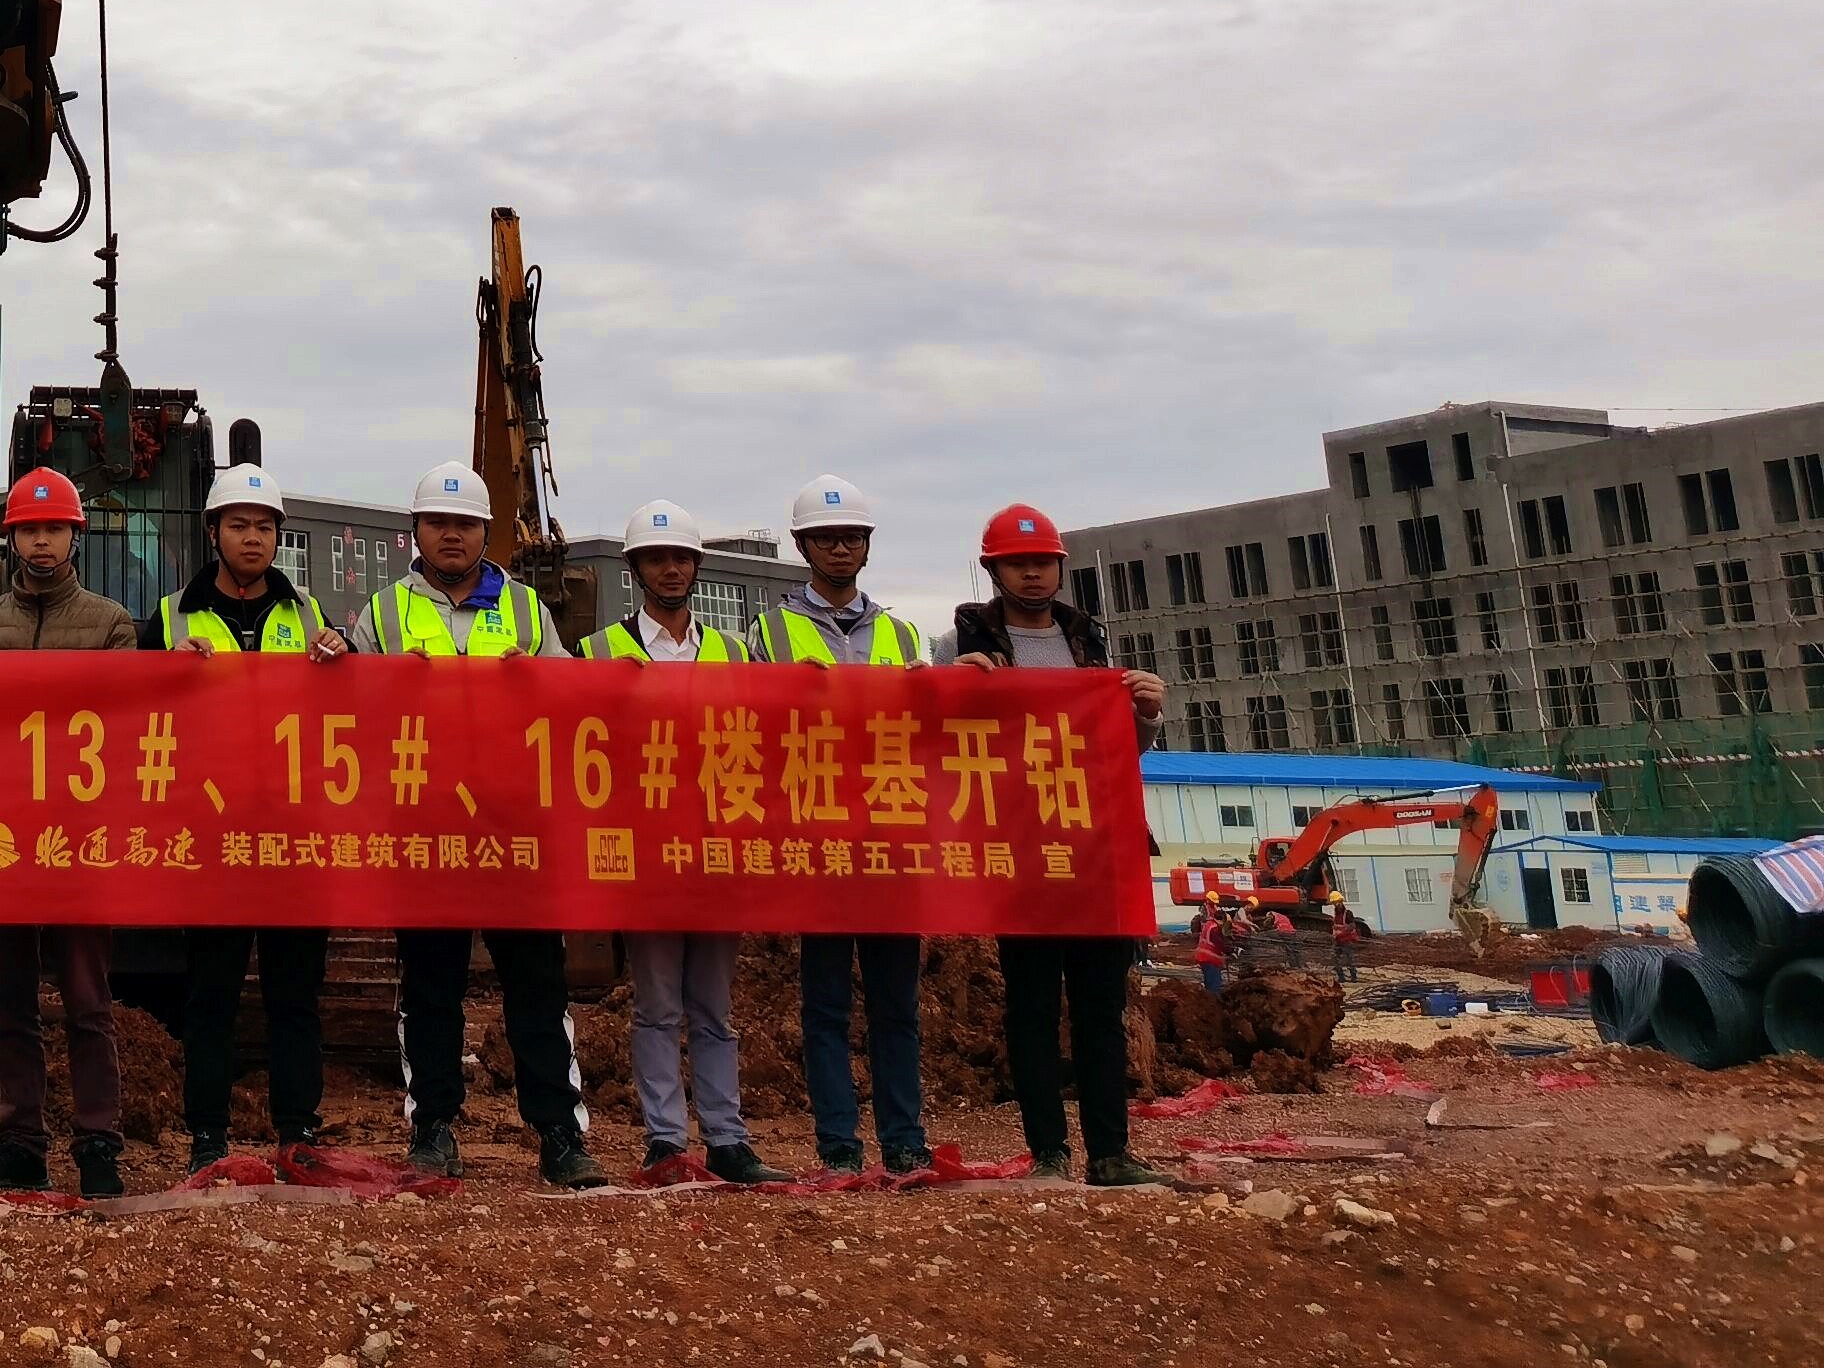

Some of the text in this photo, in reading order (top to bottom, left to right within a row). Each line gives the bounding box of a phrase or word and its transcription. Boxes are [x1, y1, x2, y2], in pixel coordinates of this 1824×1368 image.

[397, 533, 405, 548] 5
[221, 831, 540, 871] 装配式建筑有限公司
[662, 835, 1077, 879] 中国建筑第五工程局 宣
